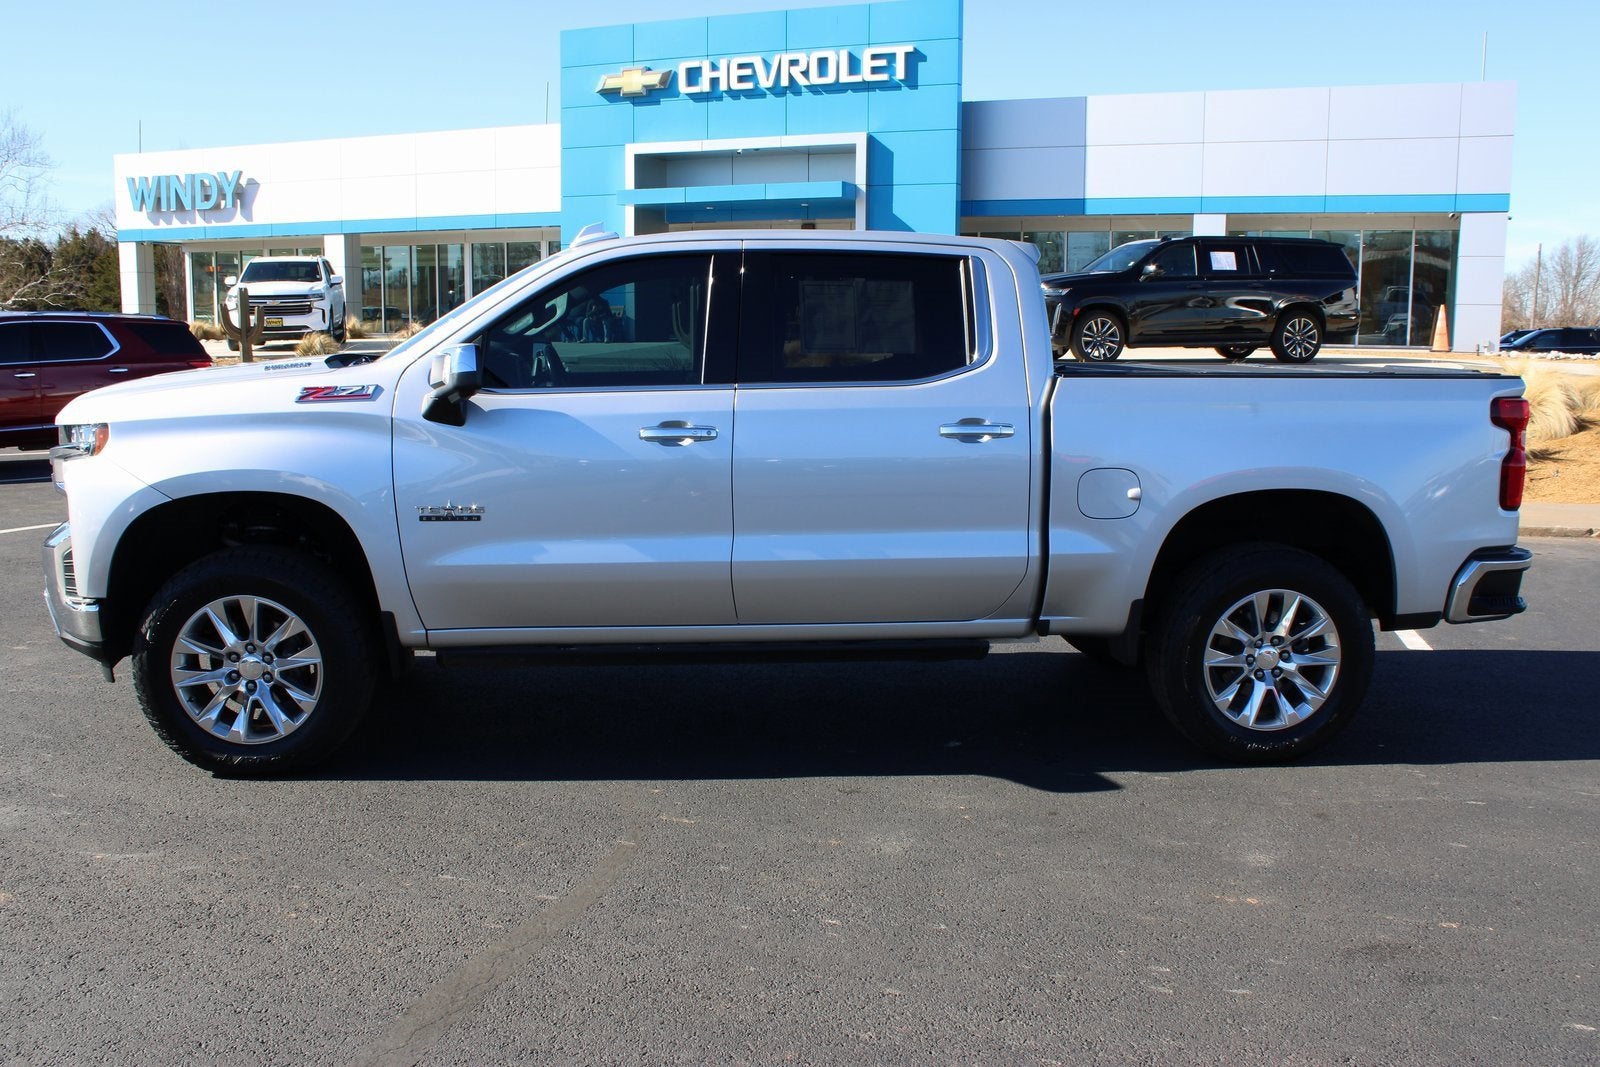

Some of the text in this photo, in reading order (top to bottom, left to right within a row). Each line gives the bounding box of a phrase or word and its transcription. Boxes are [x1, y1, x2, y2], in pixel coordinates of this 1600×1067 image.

[678, 45, 914, 94] CHEVROLET
[126, 170, 242, 212] WINDY
[298, 384, 377, 401] Z71
